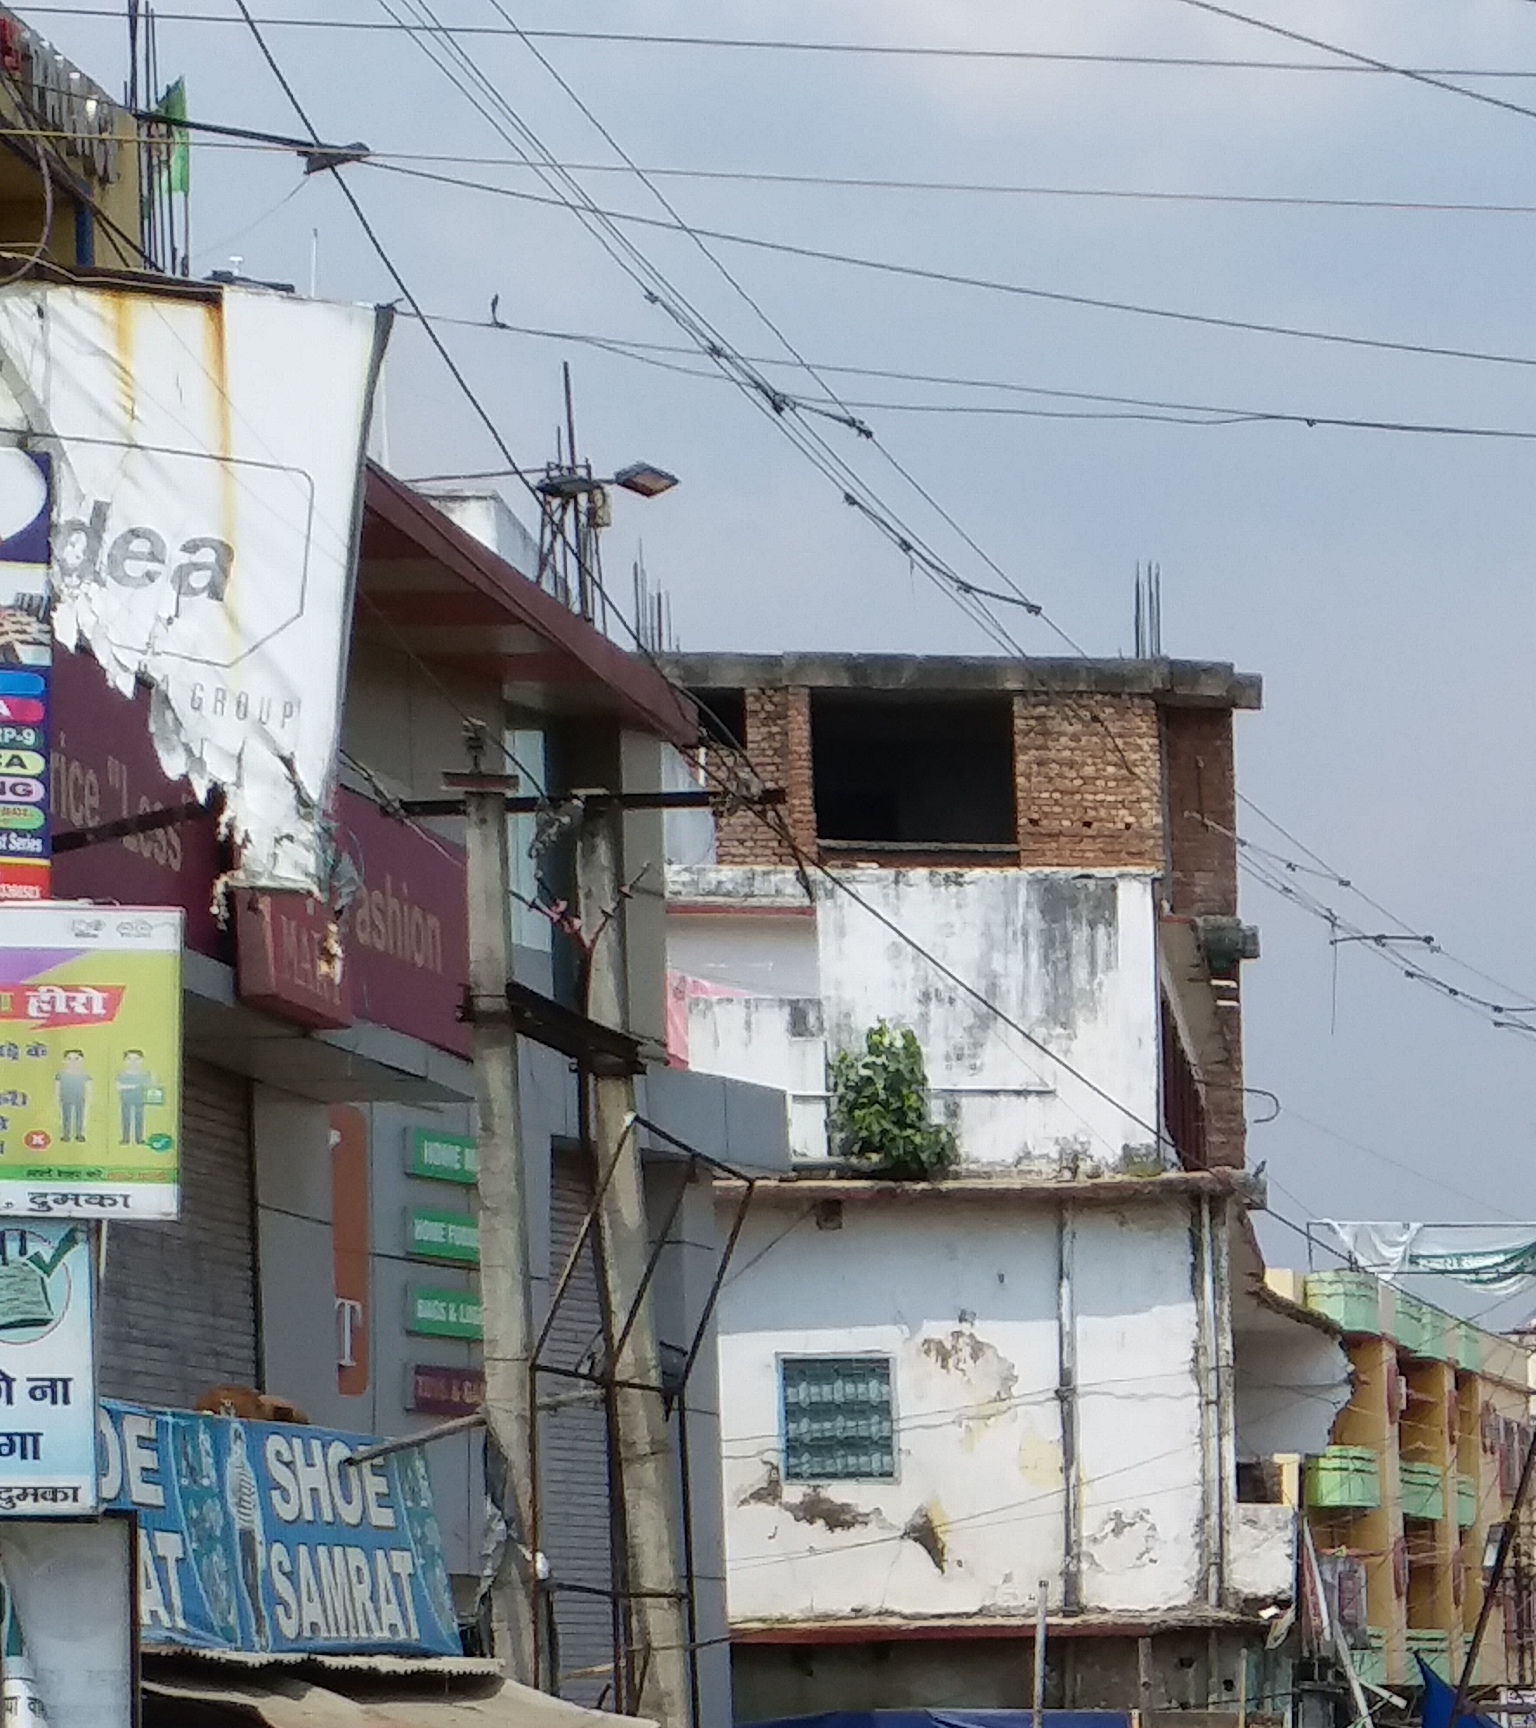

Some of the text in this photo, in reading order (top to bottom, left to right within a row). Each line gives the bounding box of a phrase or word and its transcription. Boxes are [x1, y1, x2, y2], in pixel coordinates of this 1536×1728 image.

[189, 683, 293, 730] GROUP
[26, 986, 109, 1017] हीरो
[27, 1191, 131, 1212] दुमका
[264, 1432, 397, 1529] SHOE
[269, 1541, 421, 1641] SAMRAT
